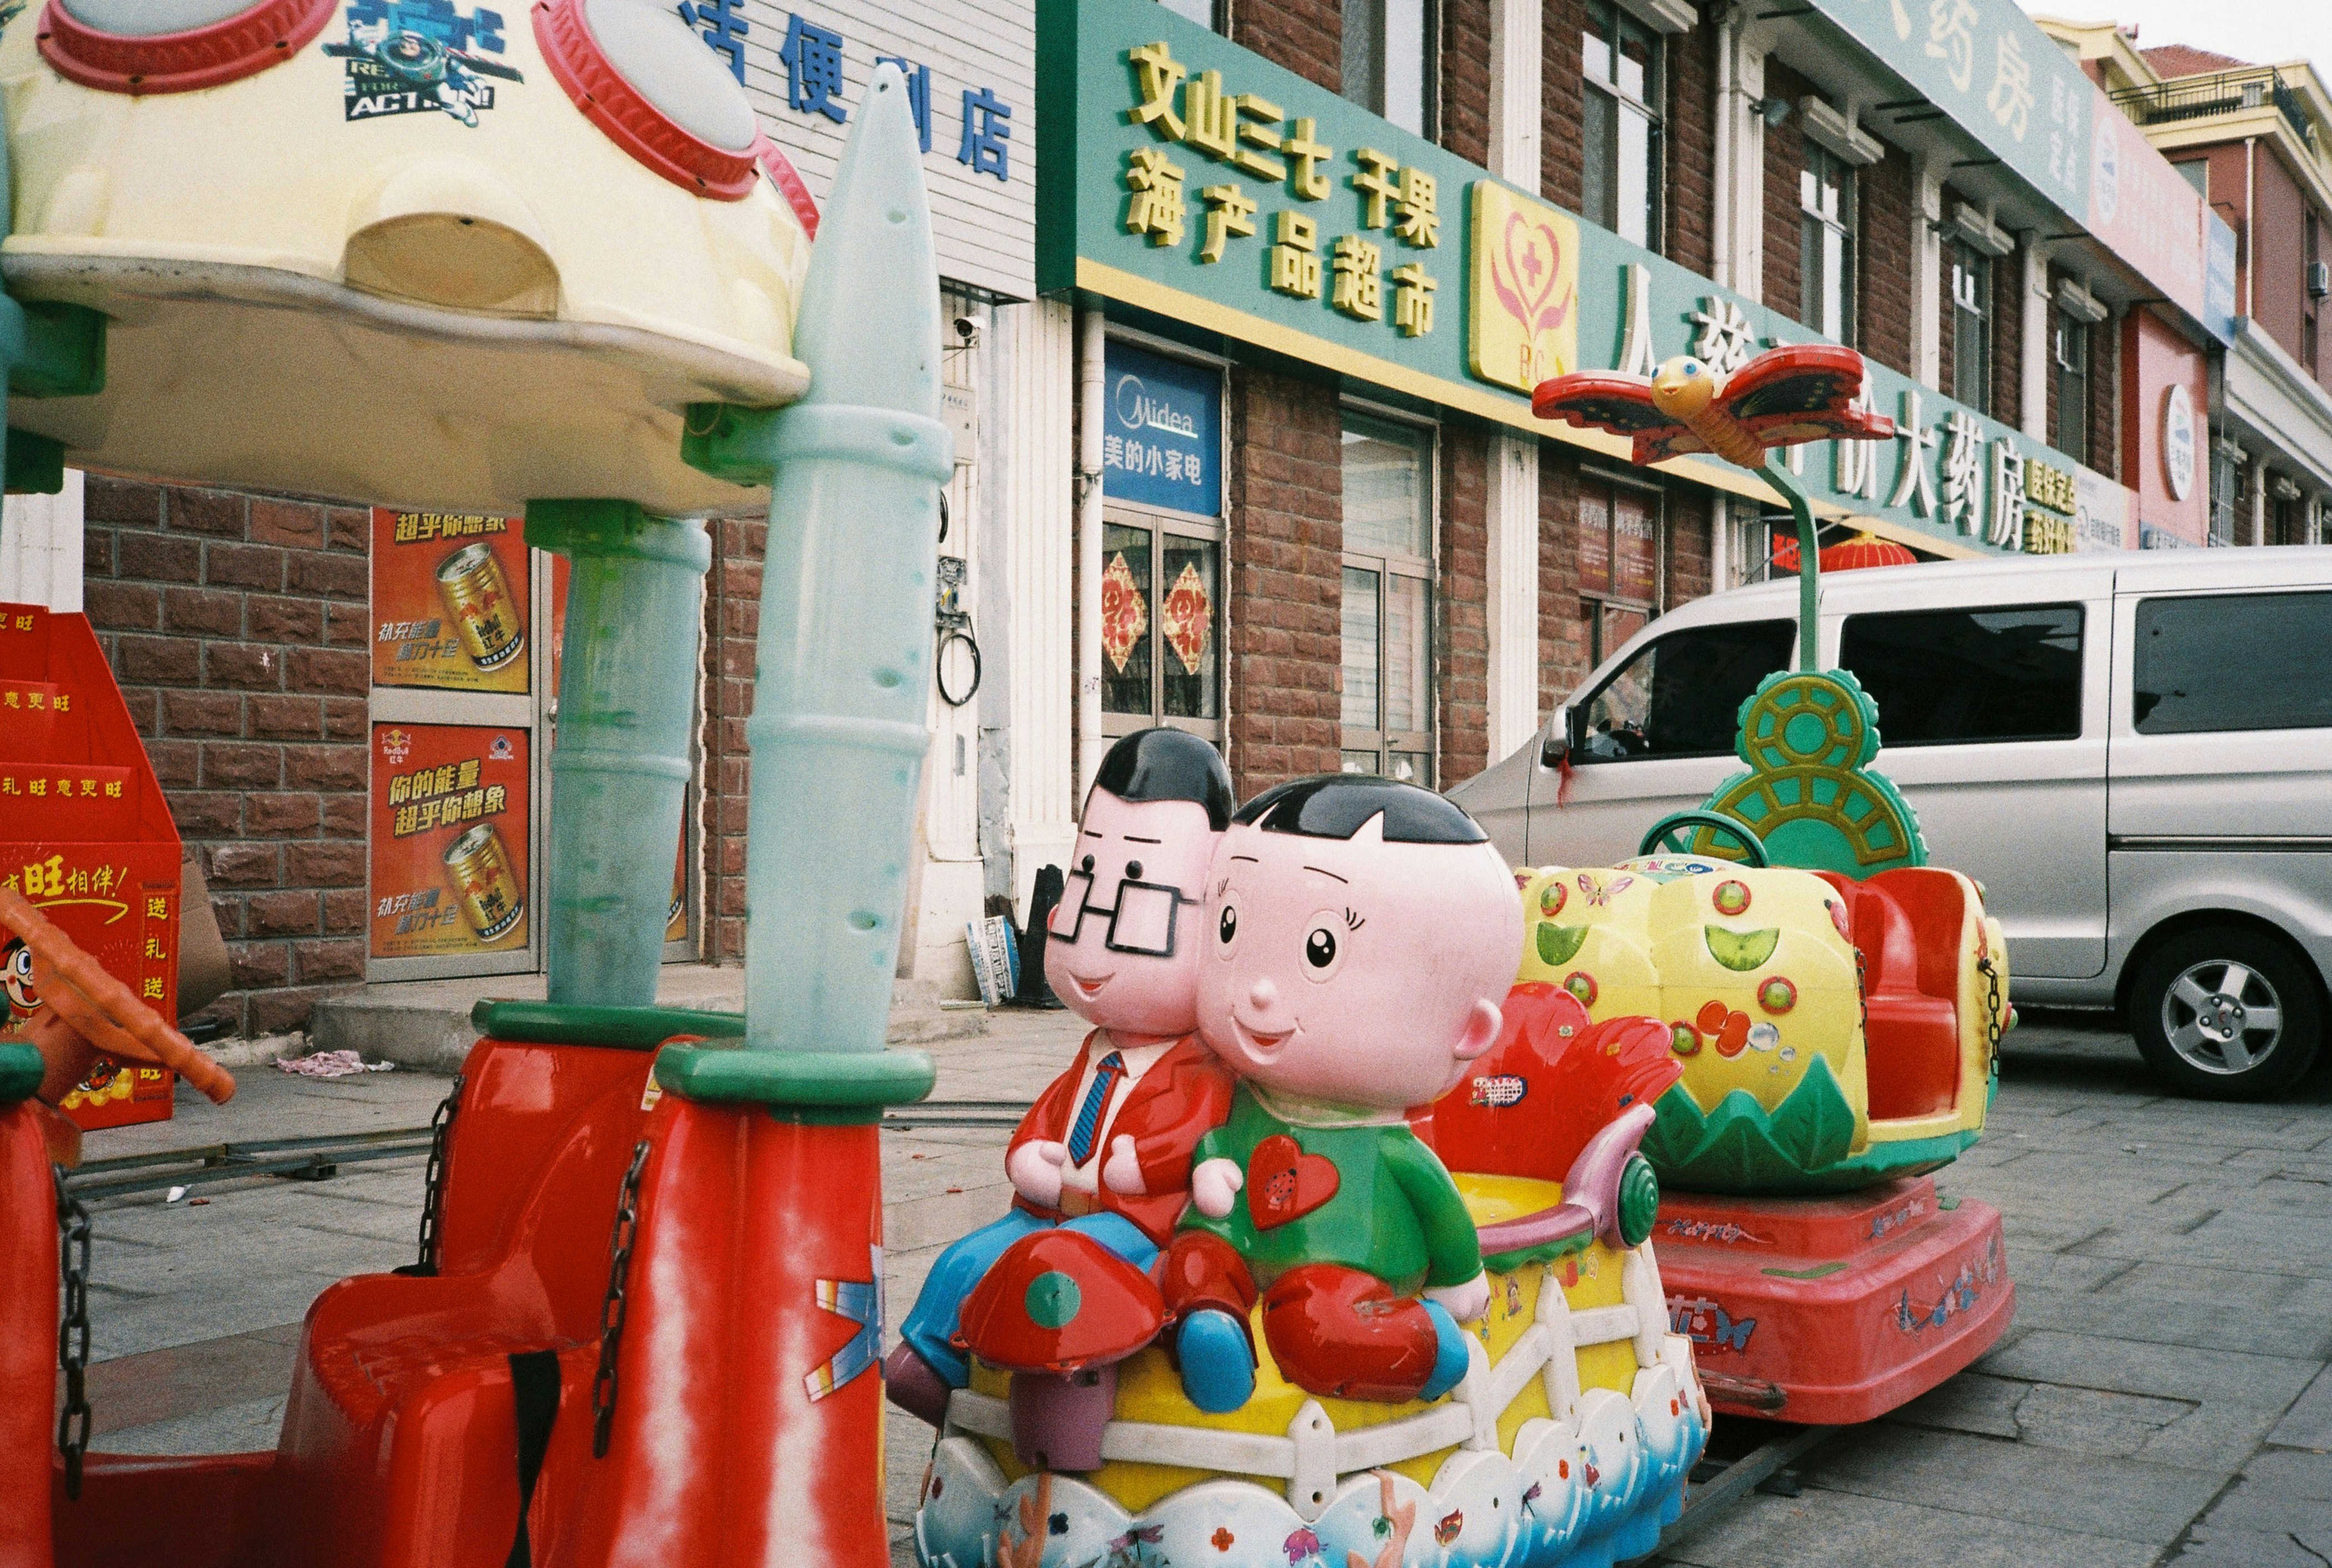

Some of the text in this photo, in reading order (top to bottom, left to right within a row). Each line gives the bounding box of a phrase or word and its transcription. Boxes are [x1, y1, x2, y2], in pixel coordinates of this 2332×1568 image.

[1128, 41, 1440, 249] 文山三七 干果
[1127, 147, 1438, 337] 海产品超市
[1116, 374, 1194, 433] Midea
[1104, 434, 1202, 491] 美的小家电
[390, 760, 480, 806] 你的能量
[394, 786, 505, 836] 超乎你想象
